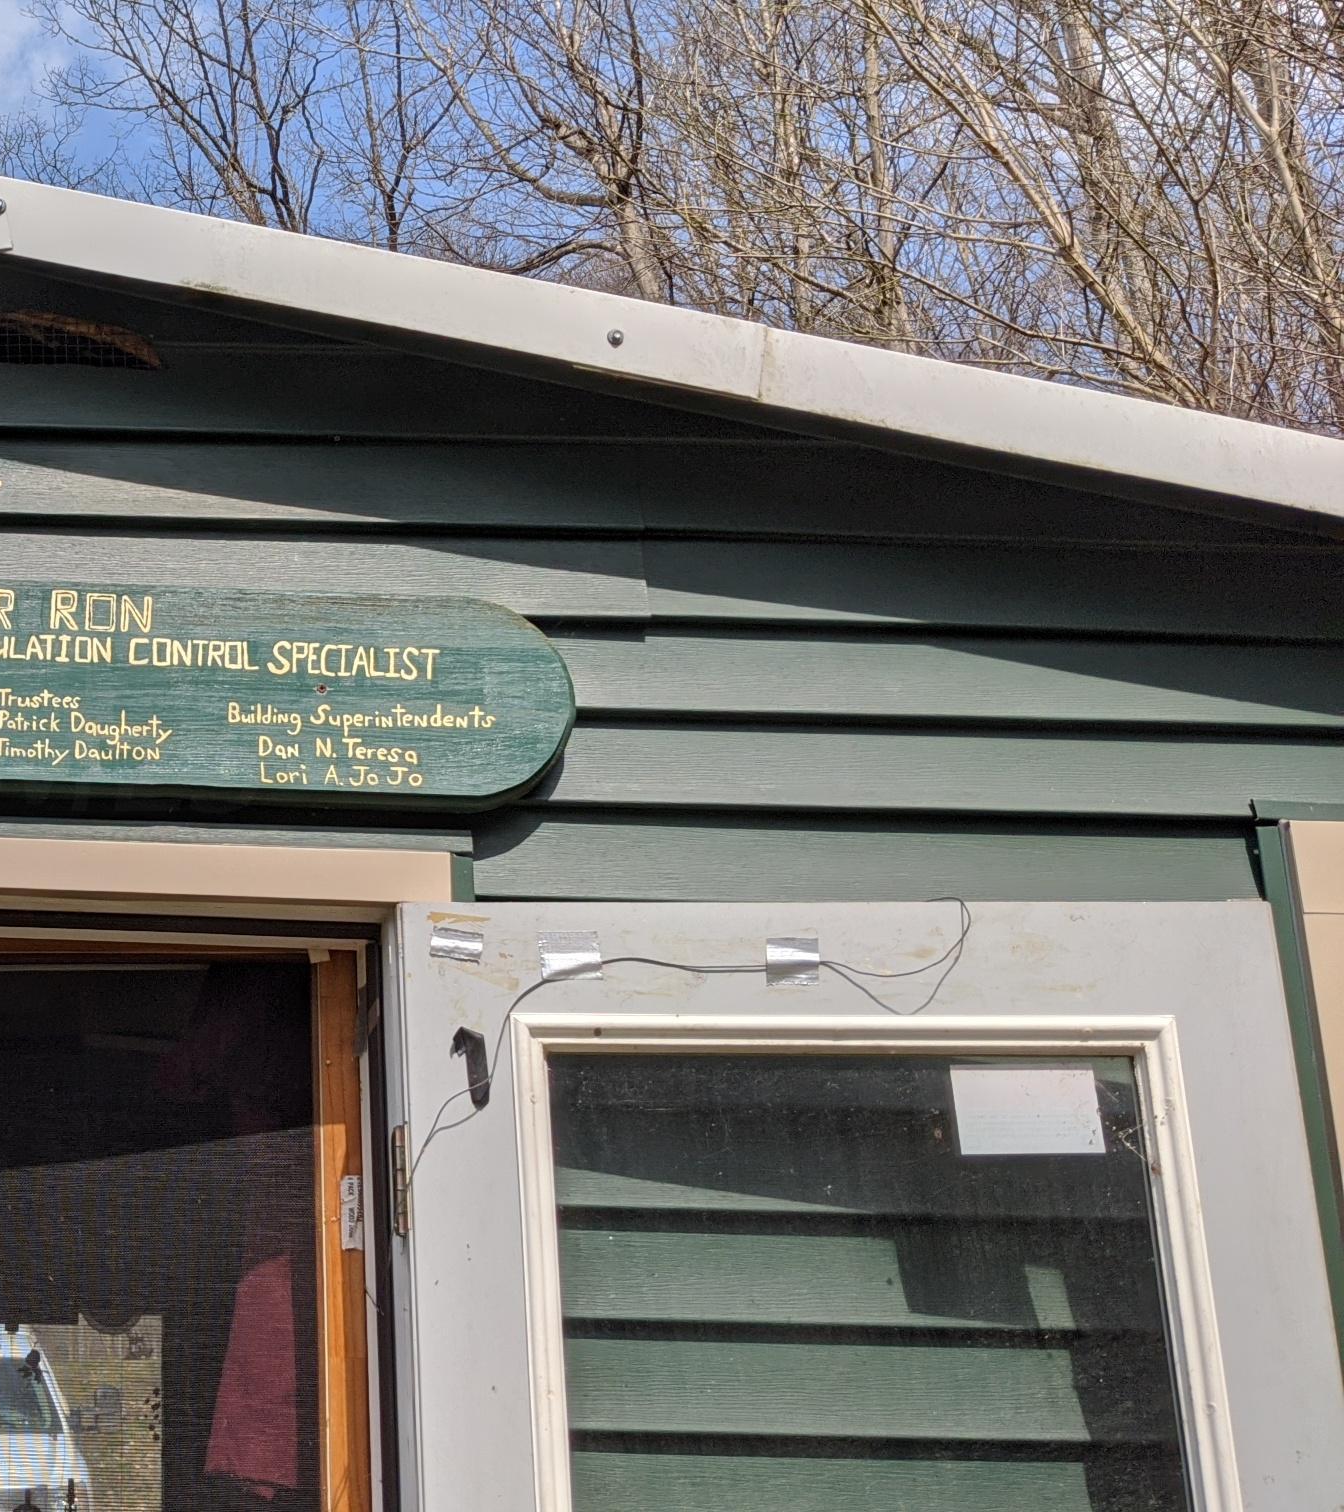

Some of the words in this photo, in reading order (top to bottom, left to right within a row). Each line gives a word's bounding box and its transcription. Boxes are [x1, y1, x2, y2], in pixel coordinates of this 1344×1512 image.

[50, 589, 152, 633] RON
[129, 637, 258, 671] CONTROL
[267, 640, 441, 680] SPECIALIST
[70, 709, 173, 745] Daugherty
[227, 701, 301, 735] Building
[310, 703, 497, 736] Superintendents
[342, 738, 419, 765] Teresa
[260, 761, 308, 786] Lori
